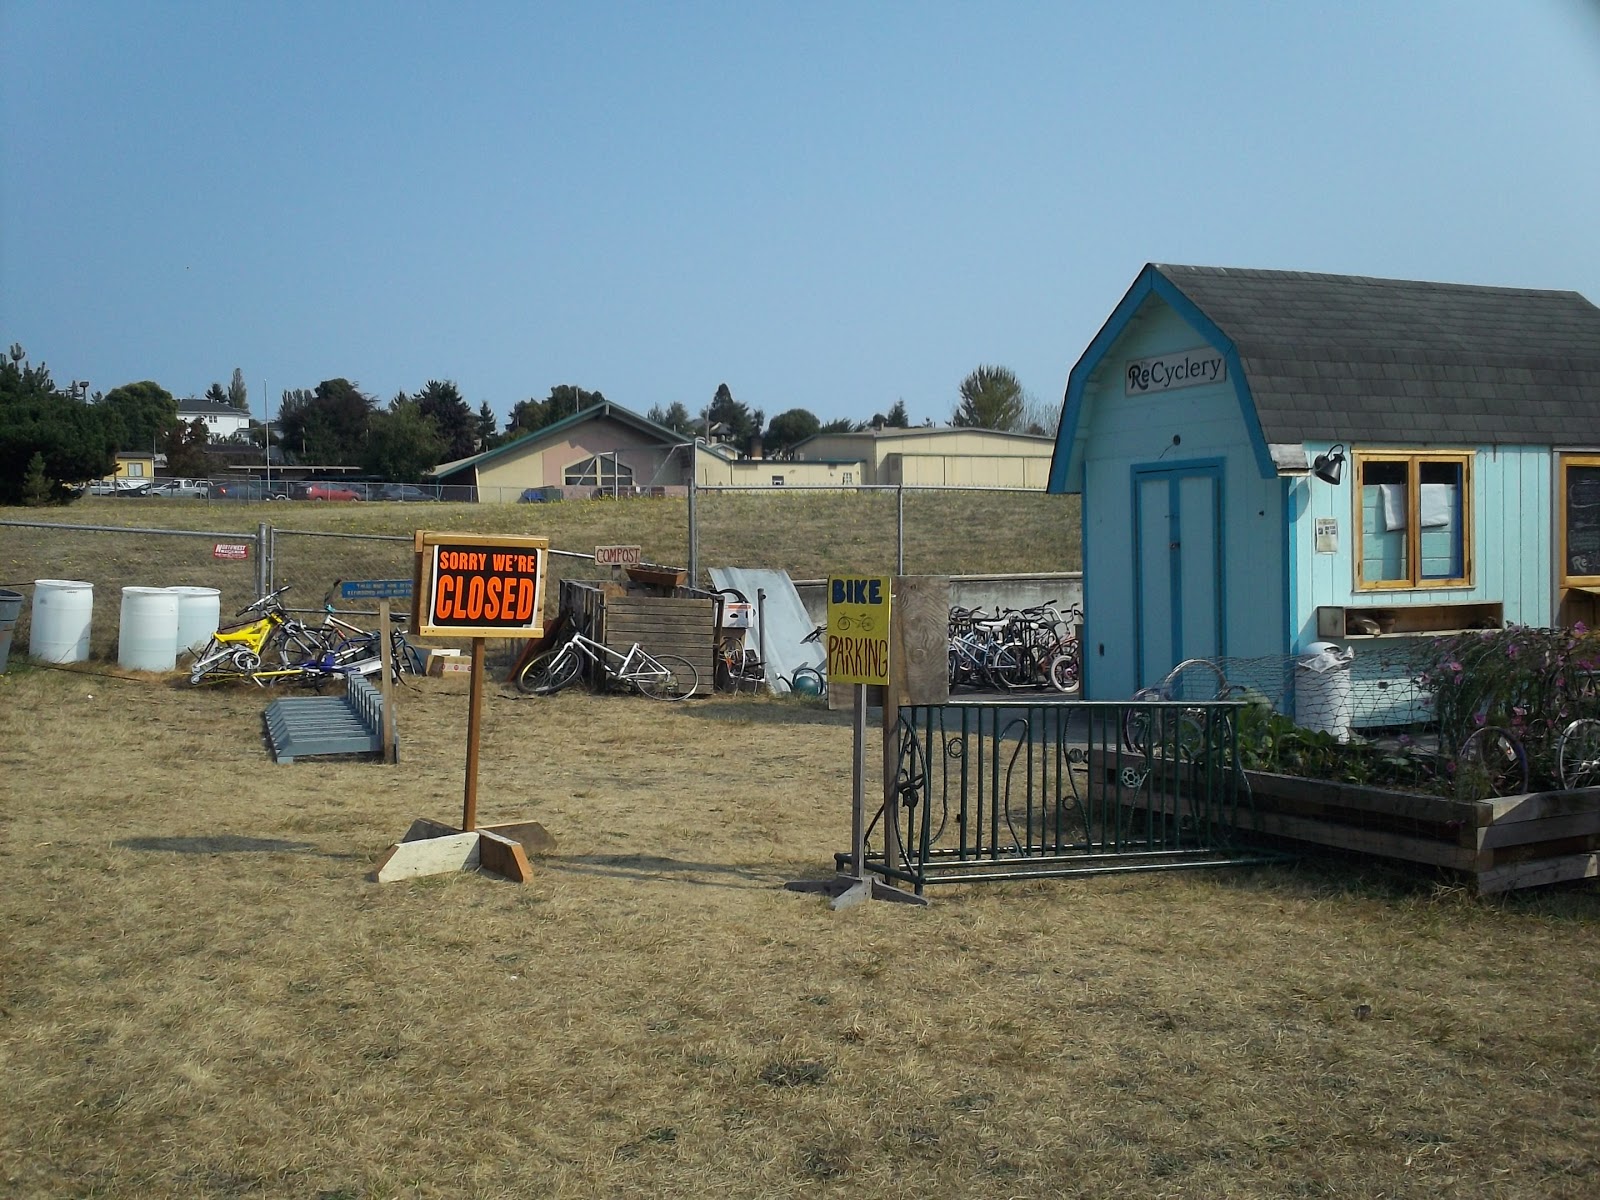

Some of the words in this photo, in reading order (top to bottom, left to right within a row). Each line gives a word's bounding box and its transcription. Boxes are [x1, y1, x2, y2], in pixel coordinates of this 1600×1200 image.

[1128, 357, 1222, 390] ReCyclery
[440, 551, 487, 571] SORRY
[493, 553, 535, 573] WE'RE
[597, 548, 640, 563] COMPOST
[436, 574, 534, 620] CLOSED
[831, 579, 883, 605] BIKE
[828, 634, 888, 678] PARKING
